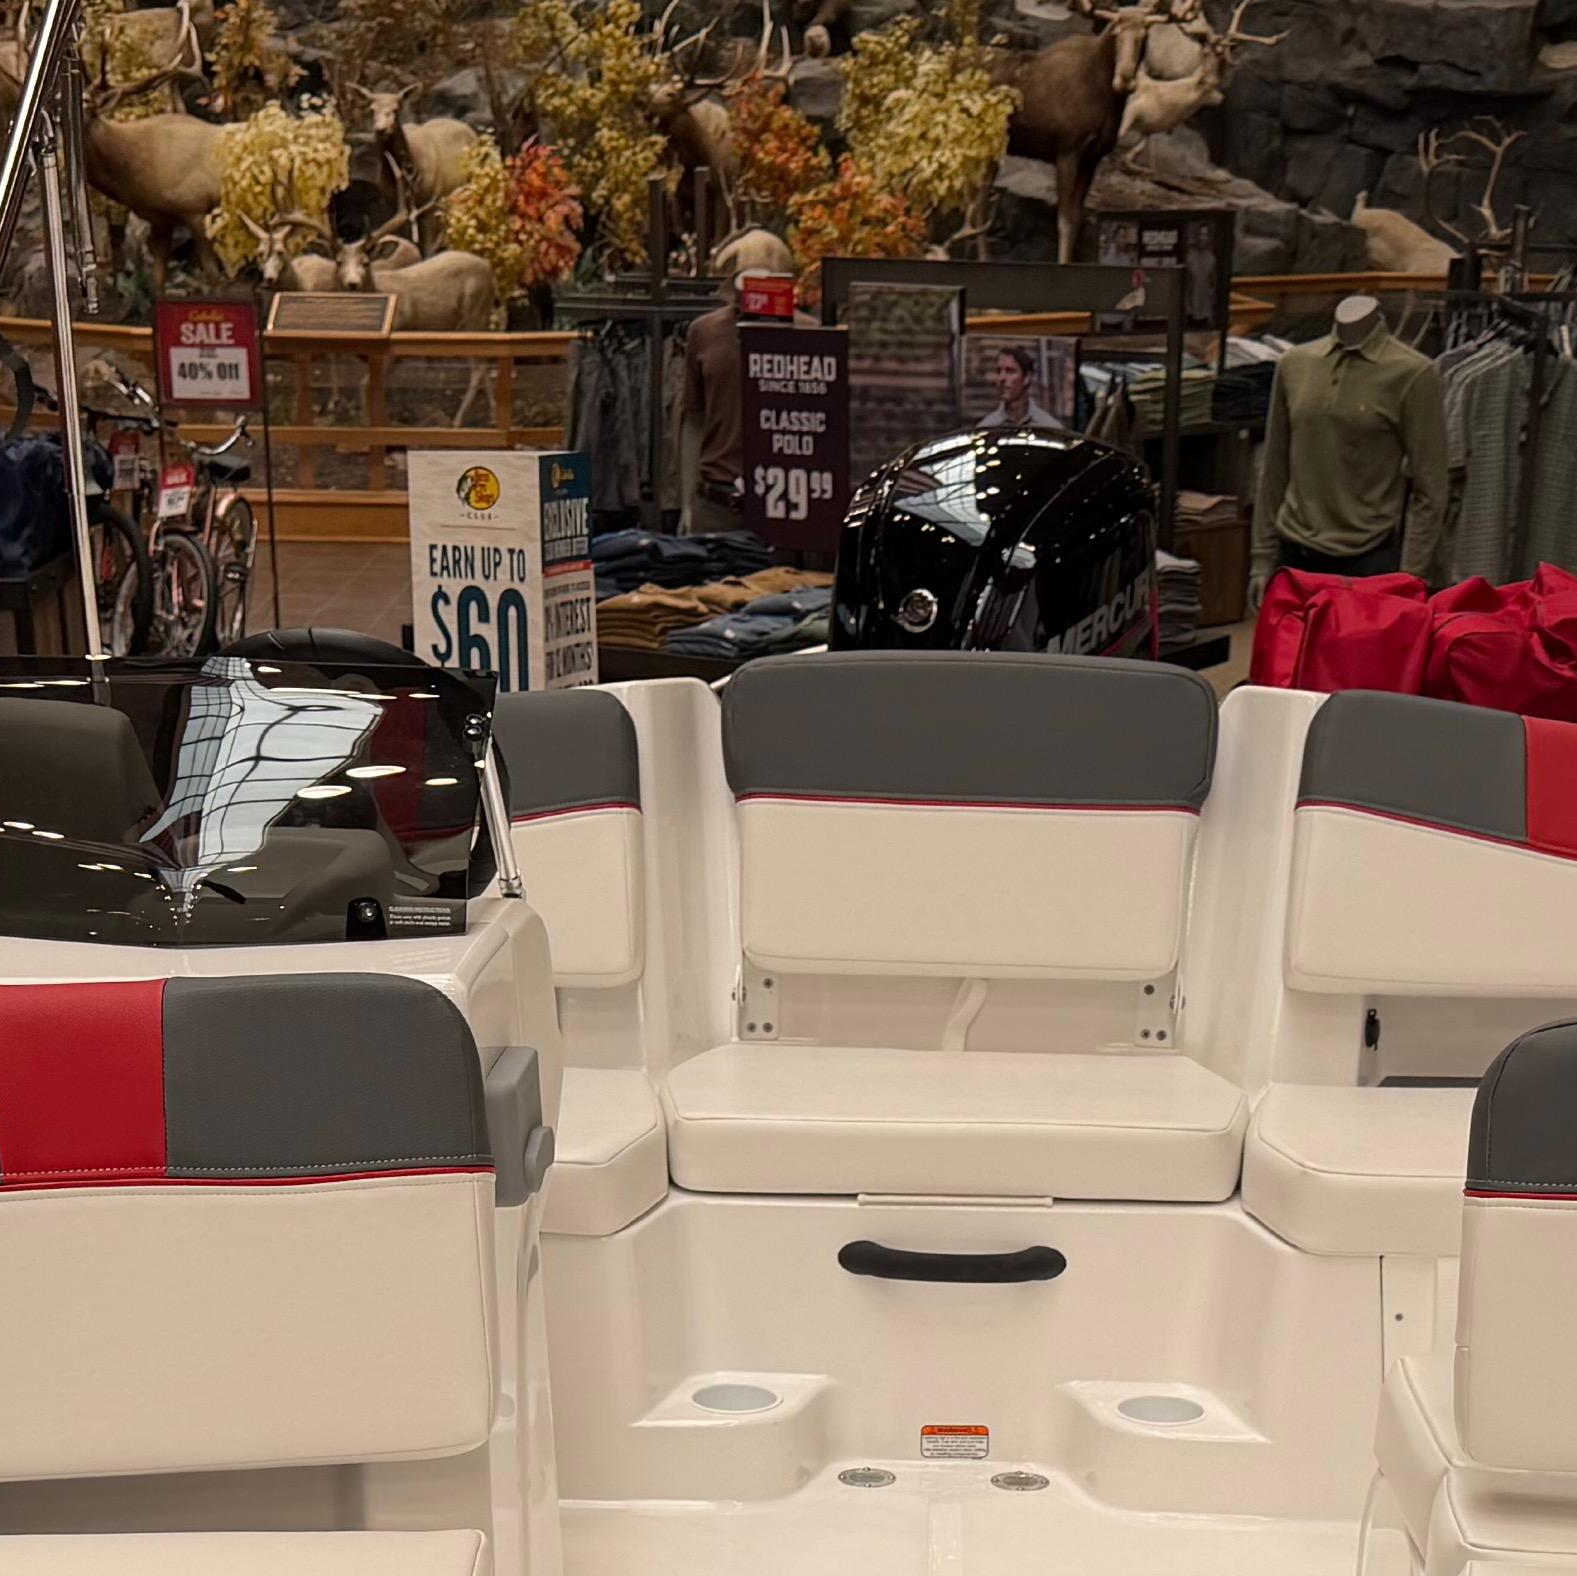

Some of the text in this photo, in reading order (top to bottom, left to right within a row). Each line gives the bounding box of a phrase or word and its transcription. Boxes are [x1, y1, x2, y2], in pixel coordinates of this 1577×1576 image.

[180, 322, 235, 345] SALE
[177, 362, 212, 381] 40%
[749, 353, 837, 383] REDHEAD
[758, 379, 795, 394] SINCE
[759, 409, 826, 433] CLASSIC
[772, 434, 814, 456] POLO
[428, 543, 475, 580] EARN
[481, 546, 502, 581] UP
[507, 547, 526, 583] TO
[1046, 566, 1151, 655] MERCUR
[430, 584, 529, 692] $60
